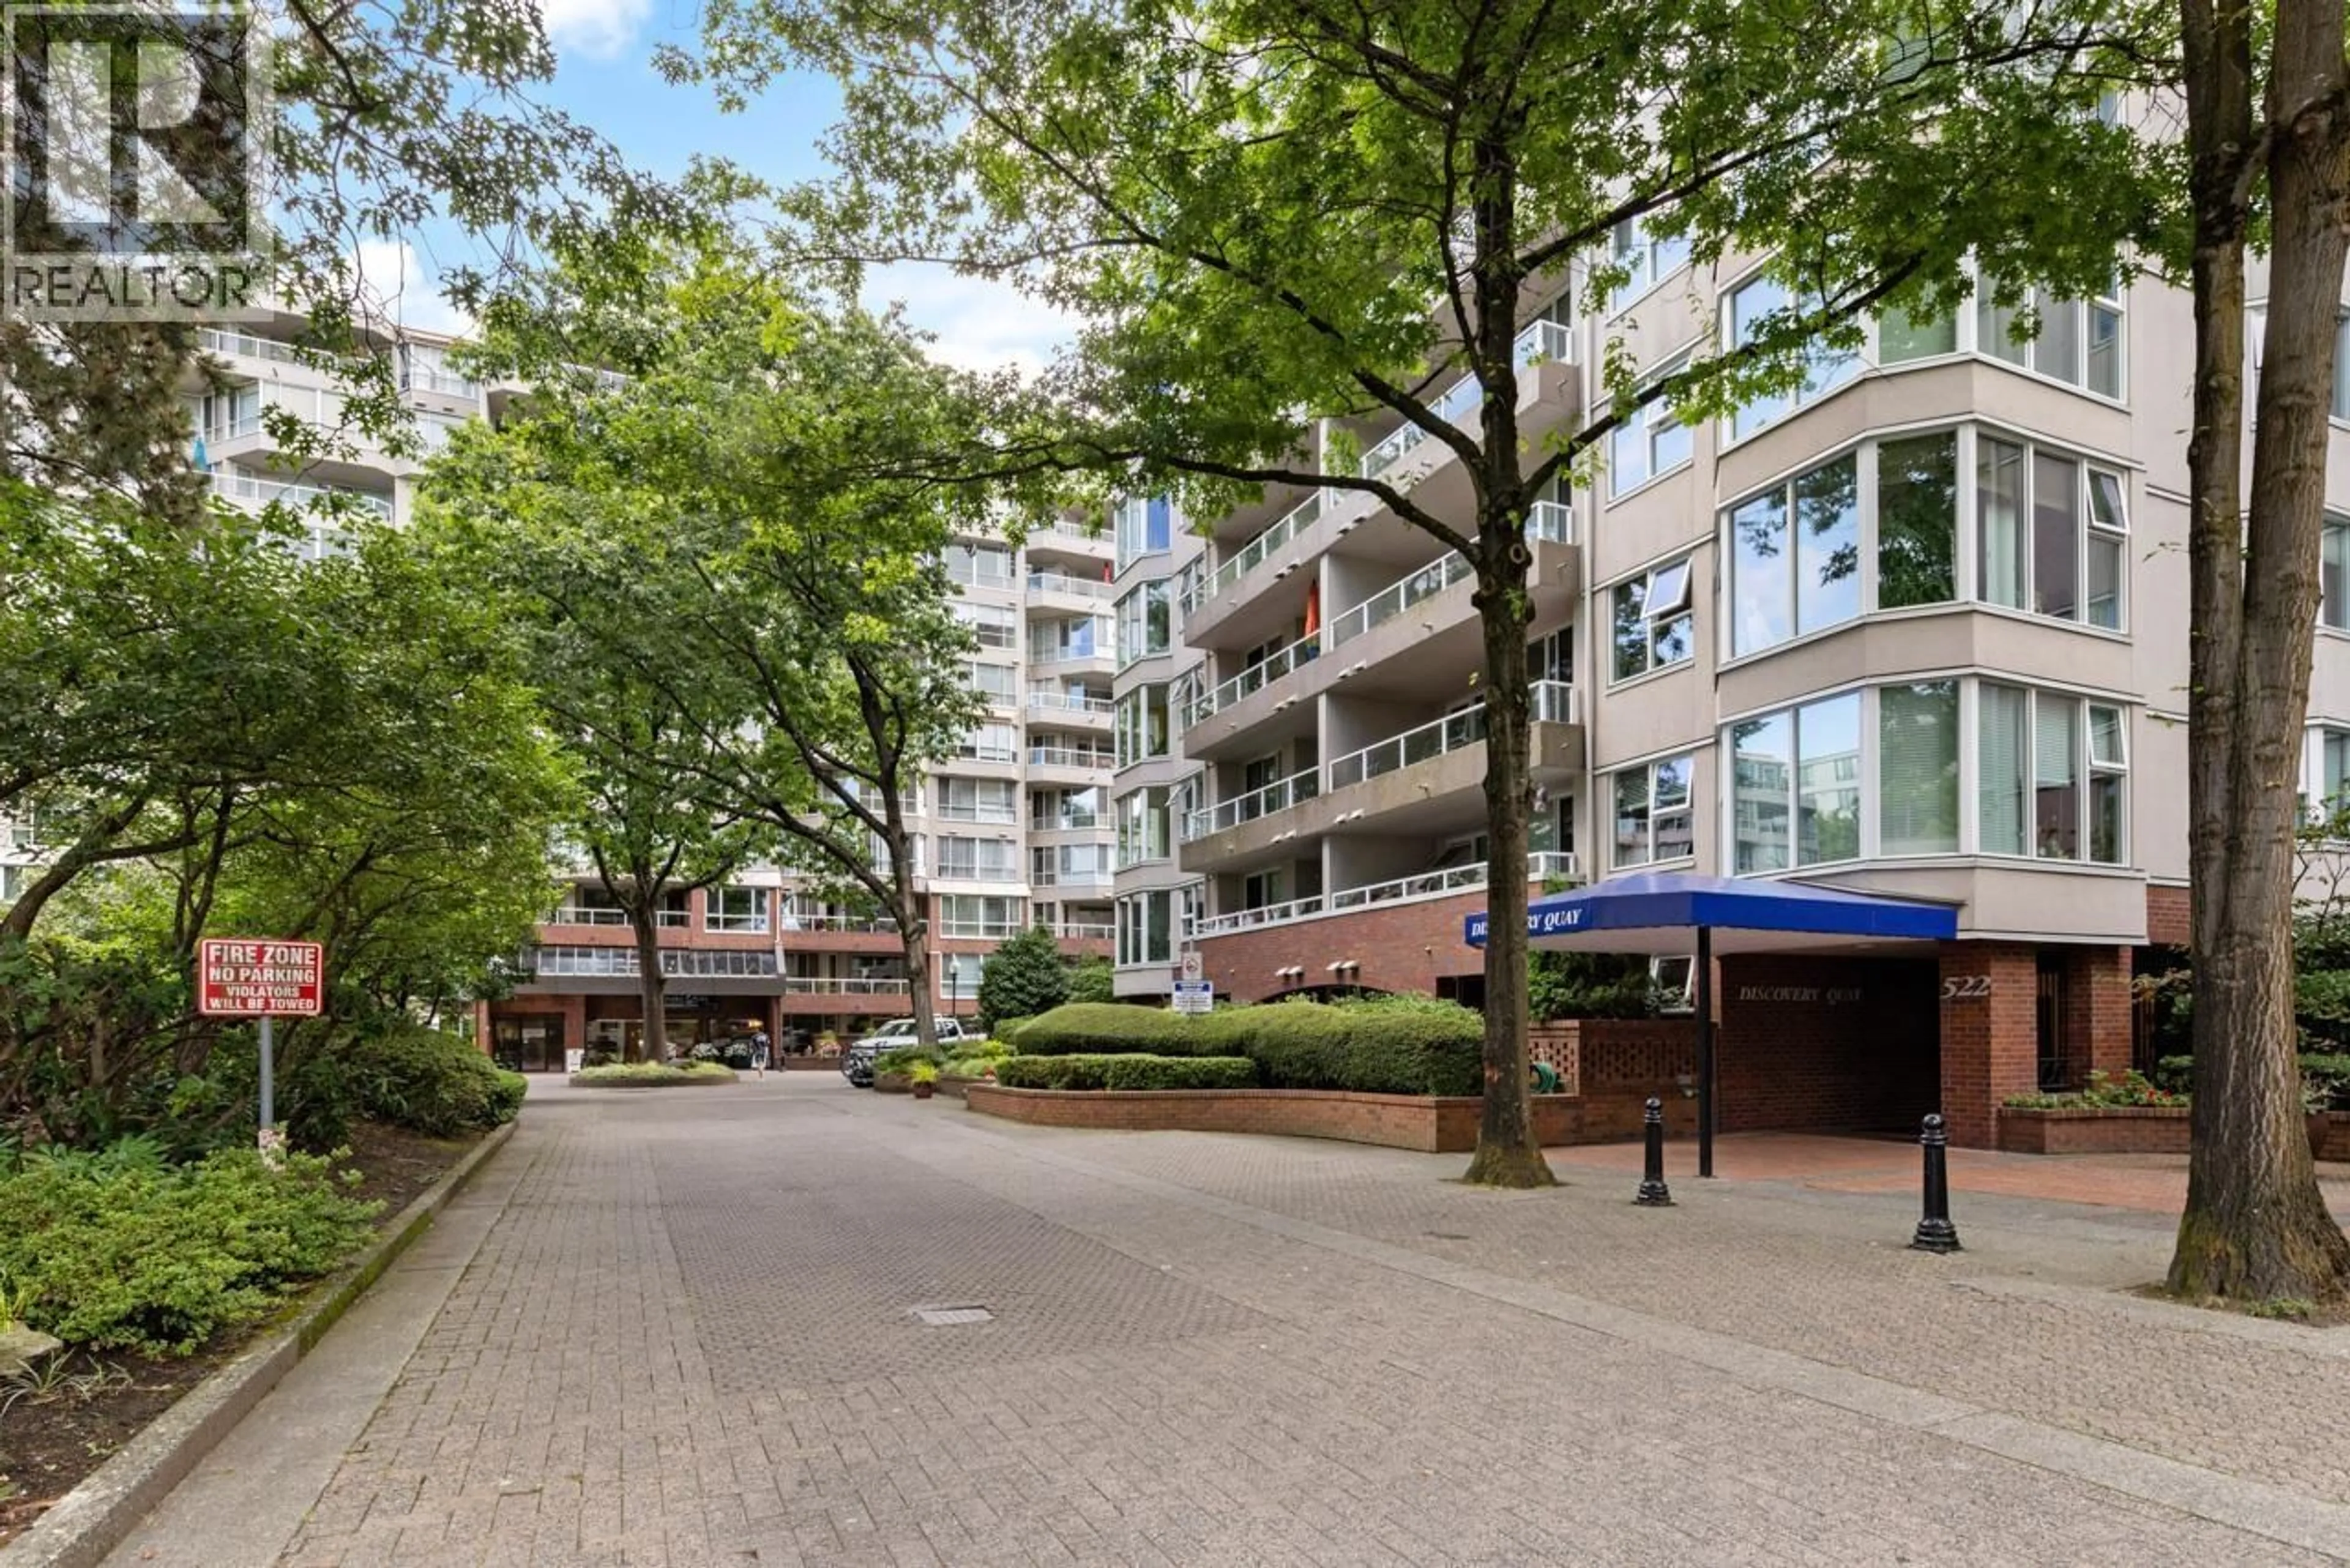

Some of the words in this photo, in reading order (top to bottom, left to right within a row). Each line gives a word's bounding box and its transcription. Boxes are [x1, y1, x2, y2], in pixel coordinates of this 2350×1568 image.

[1543, 909, 1583, 931] QUAY
[209, 944, 258, 965] FIRE
[263, 946, 315, 965] ZONE
[209, 967, 234, 982] NO
[239, 968, 315, 983] PARKING
[226, 985, 300, 998] VIOLATORS
[1739, 985, 1820, 1001] DISCOVERY
[1939, 975, 1991, 999] 522
[209, 998, 244, 1009] WILL
[247, 998, 265, 1010] BE
[269, 999, 315, 1010] TOWED
